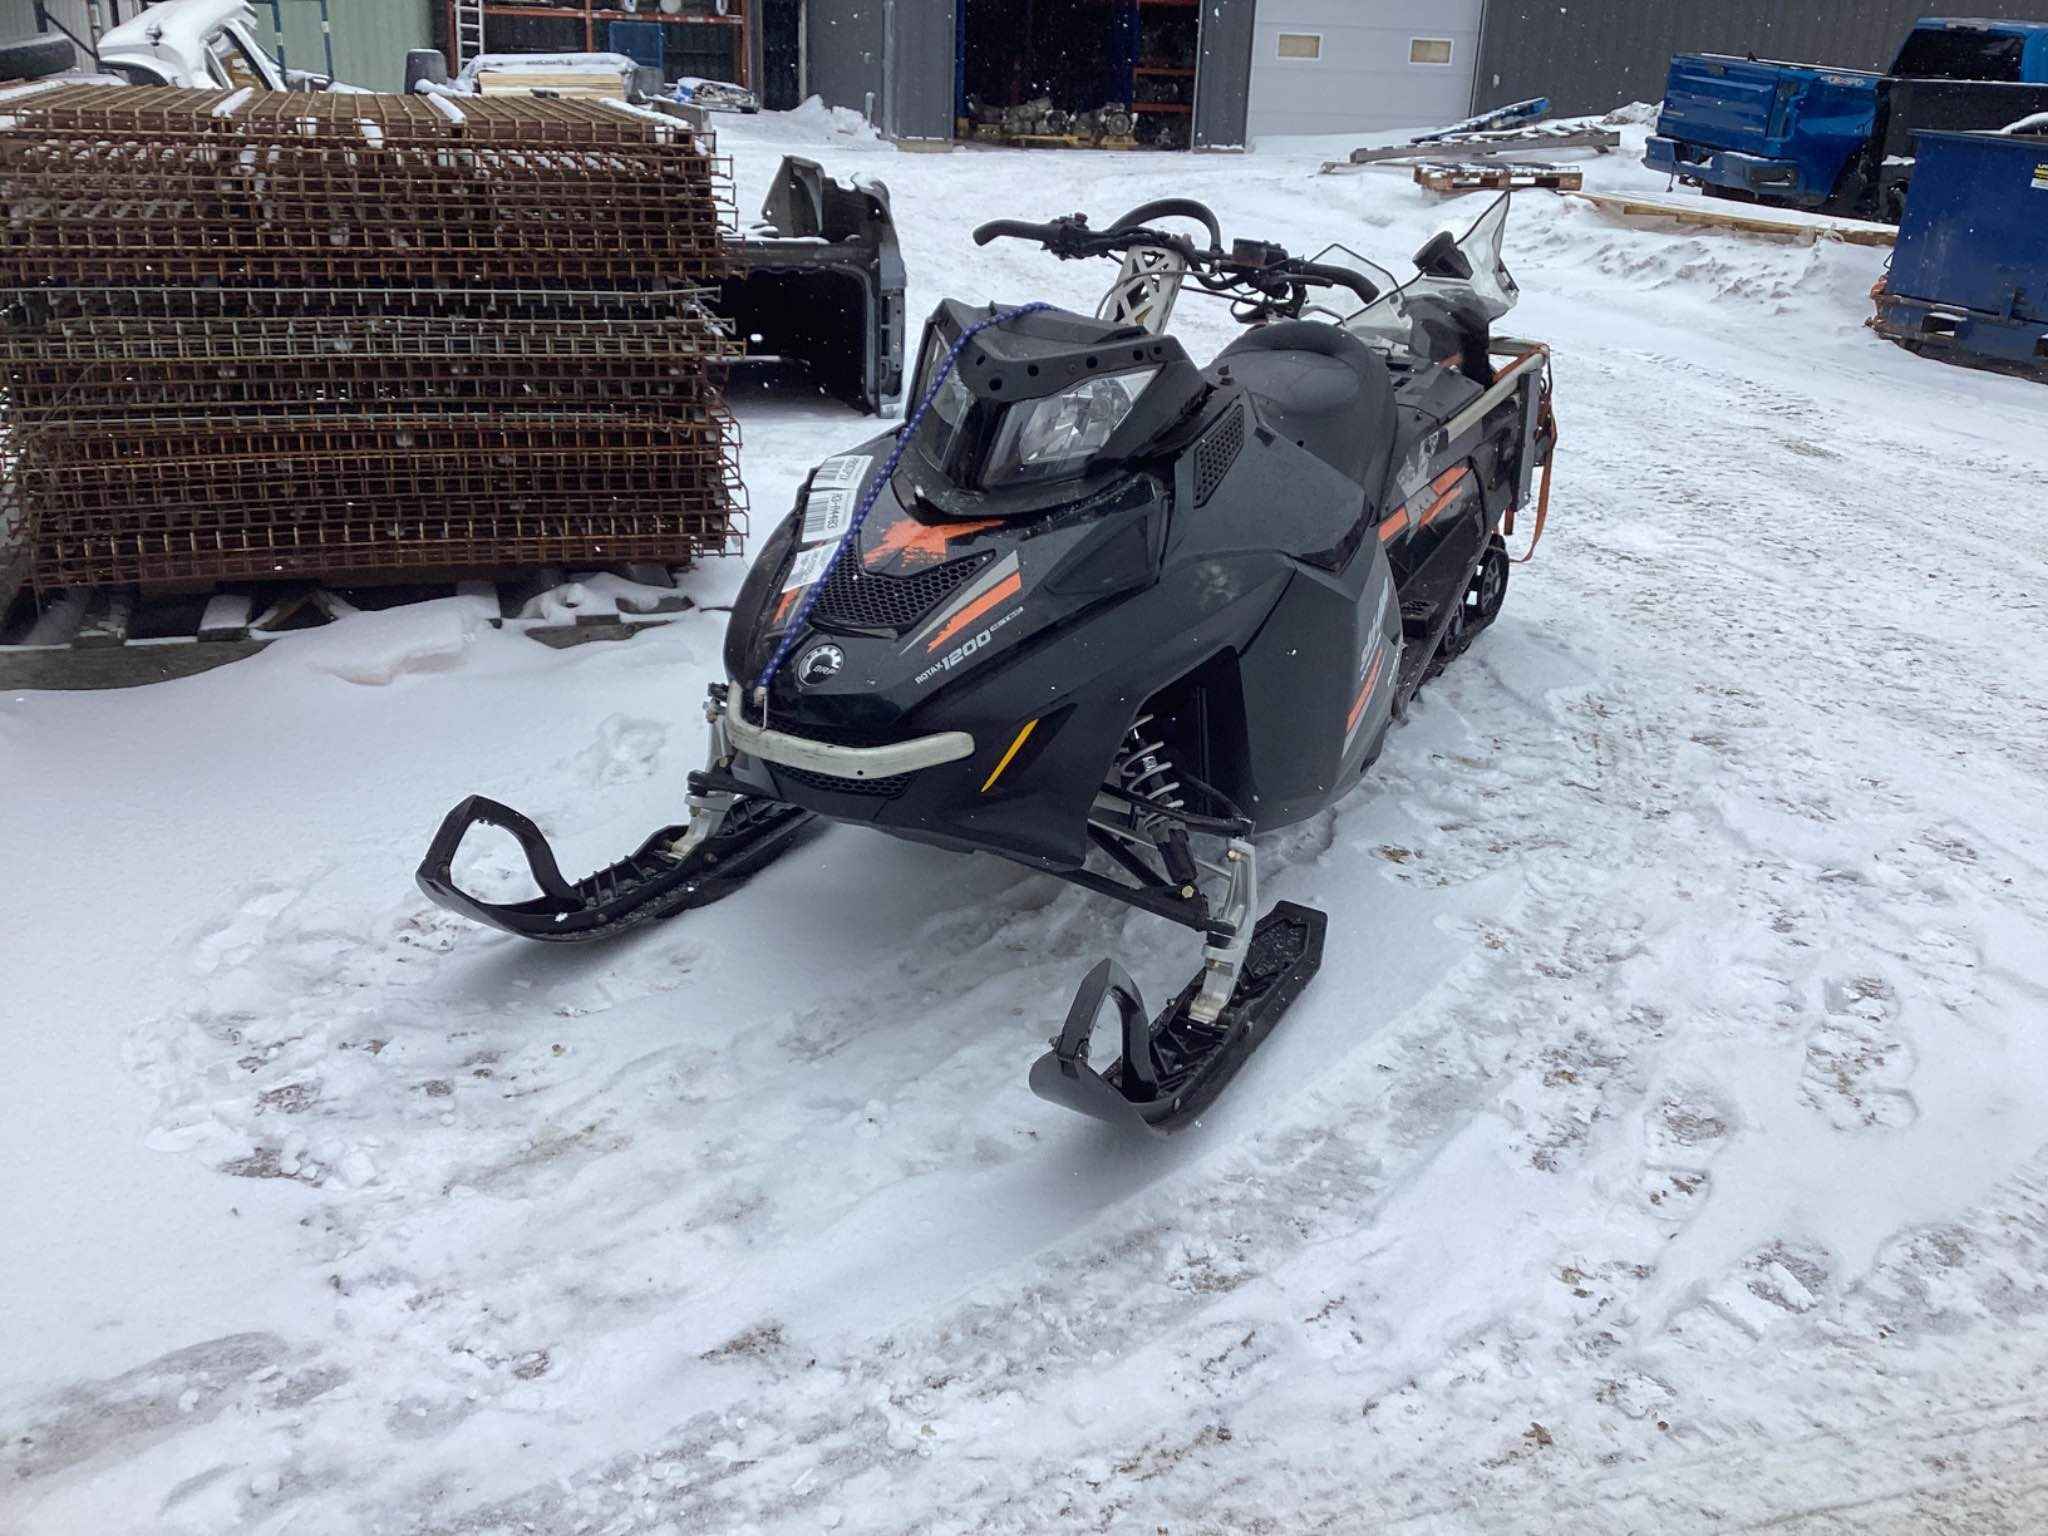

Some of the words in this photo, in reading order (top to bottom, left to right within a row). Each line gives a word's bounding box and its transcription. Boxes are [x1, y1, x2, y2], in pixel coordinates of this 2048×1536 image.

[812, 664, 836, 675] BRP
[914, 661, 943, 684] ROTAX
[942, 629, 991, 671] 1200
